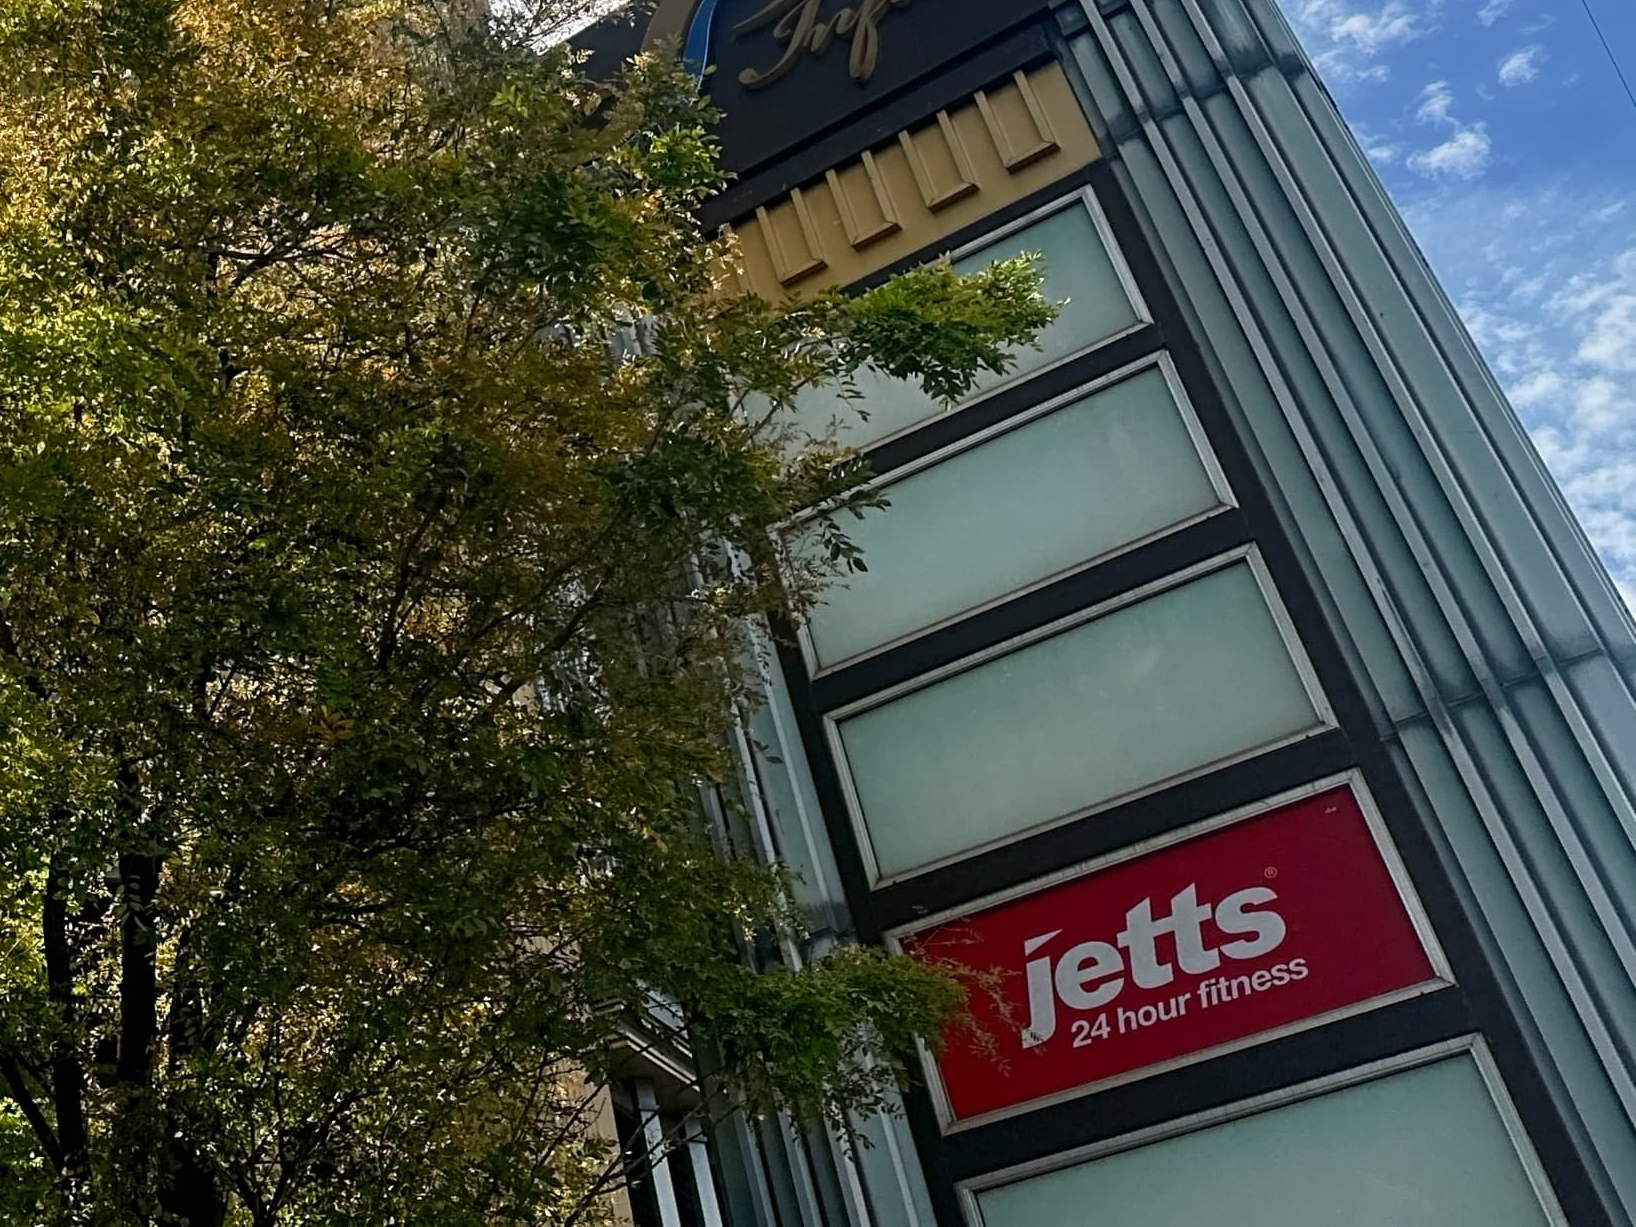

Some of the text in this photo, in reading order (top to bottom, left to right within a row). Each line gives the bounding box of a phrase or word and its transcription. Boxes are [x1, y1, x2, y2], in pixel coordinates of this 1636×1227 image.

[1022, 882, 1286, 1049] jetts
[1071, 957, 1309, 1048] 24 hour fitness
